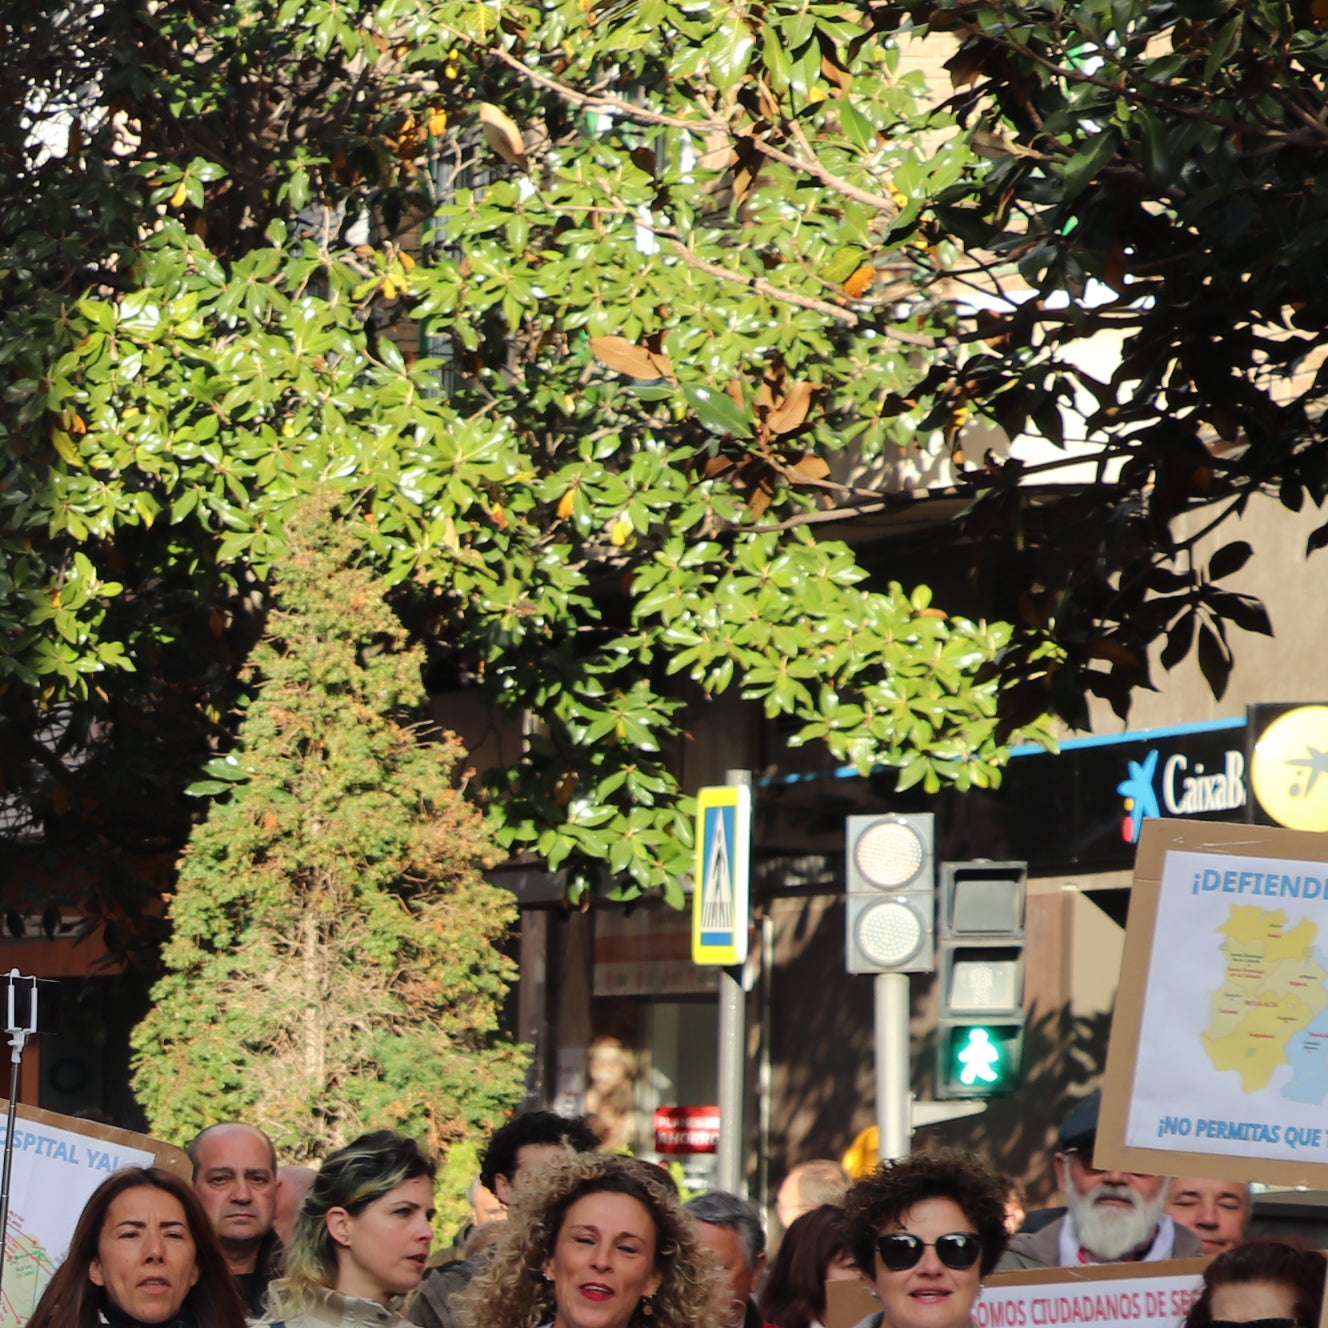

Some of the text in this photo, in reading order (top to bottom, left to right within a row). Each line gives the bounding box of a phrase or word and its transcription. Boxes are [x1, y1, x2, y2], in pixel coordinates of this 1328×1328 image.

[1162, 750, 1246, 814] CaixaB
[1192, 869, 1328, 900] ¡DEFIEND
[1158, 1115, 1320, 1149] ¡NO PERMITAS QUE
[971, 1299, 1027, 1328] OMOS
[1031, 1291, 1141, 1325] CIUDADANOS
[1145, 1290, 1167, 1318] DE
